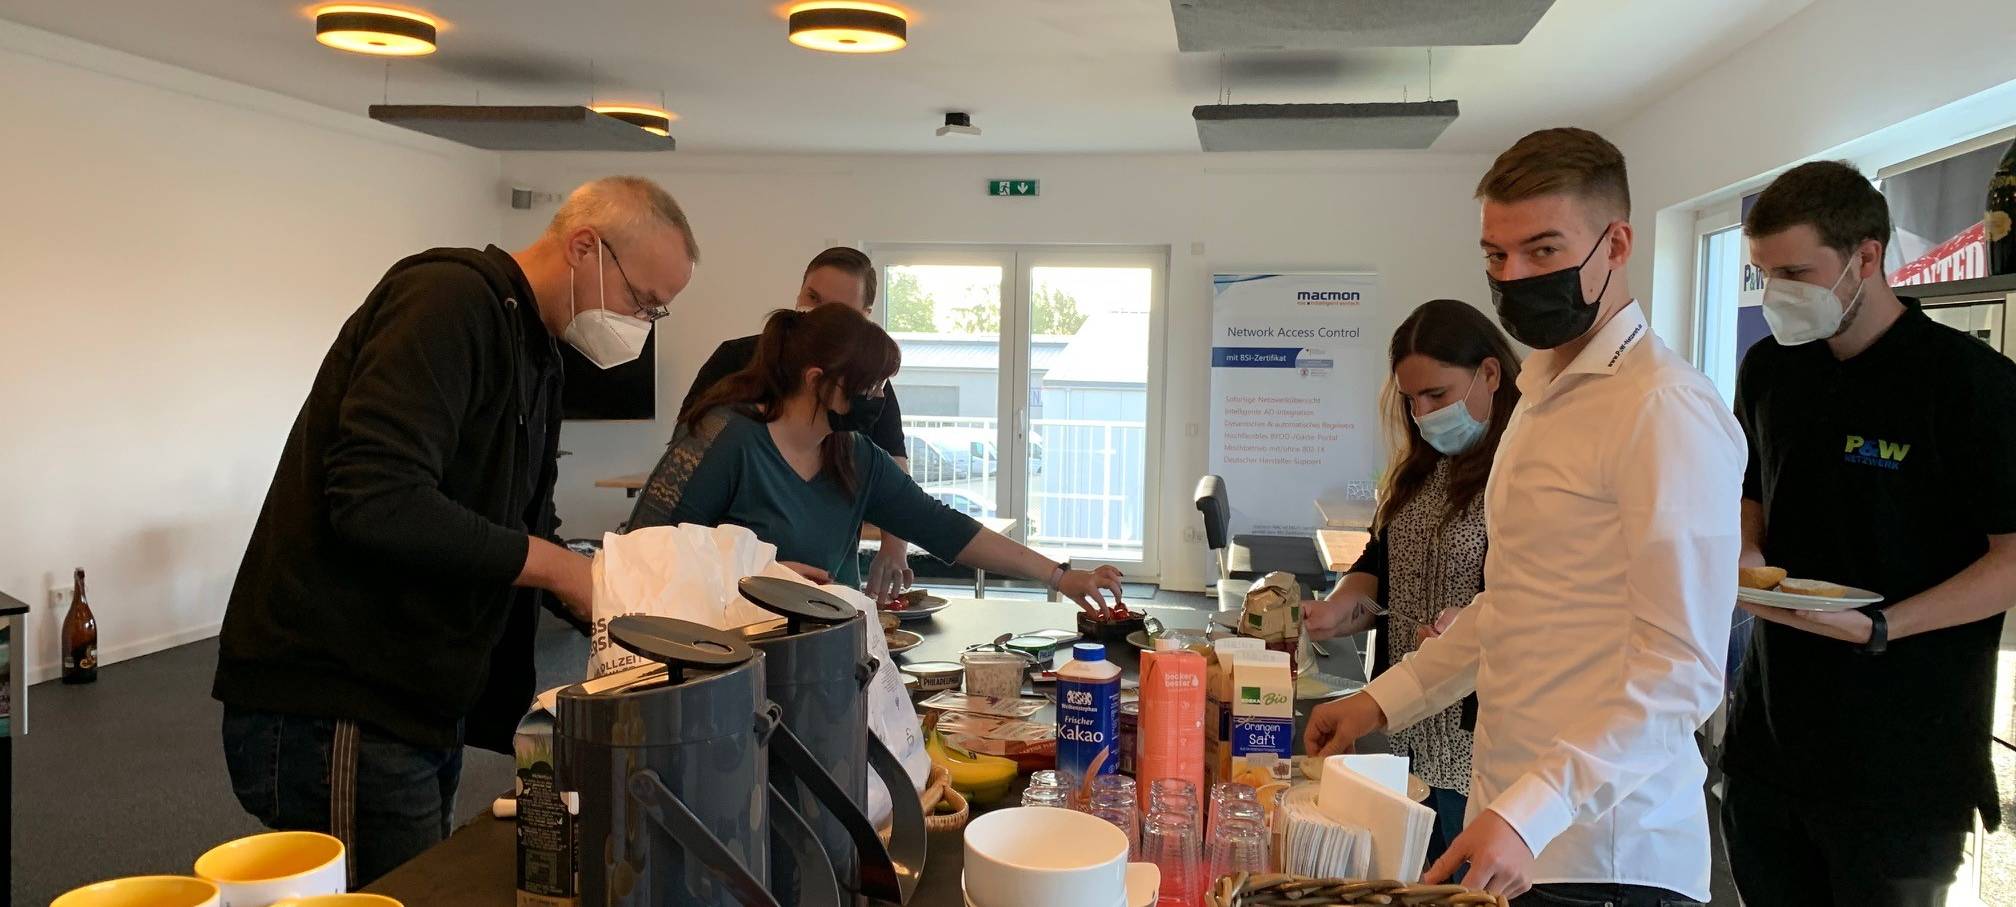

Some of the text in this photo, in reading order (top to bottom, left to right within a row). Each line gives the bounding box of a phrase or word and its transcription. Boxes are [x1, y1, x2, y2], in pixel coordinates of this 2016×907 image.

[1297, 291, 1360, 301] macmon
[1227, 327, 1360, 338] Network Access Control
[1240, 354, 1287, 362] BSI-Zertifikat
[1844, 435, 1911, 462] P&W
[1844, 453, 1900, 470] NETZWERK
[1263, 692, 1288, 706] Bio
[1064, 715, 1095, 726] Frischer
[1057, 723, 1104, 743] Kakao
[1249, 733, 1276, 746] Saft
